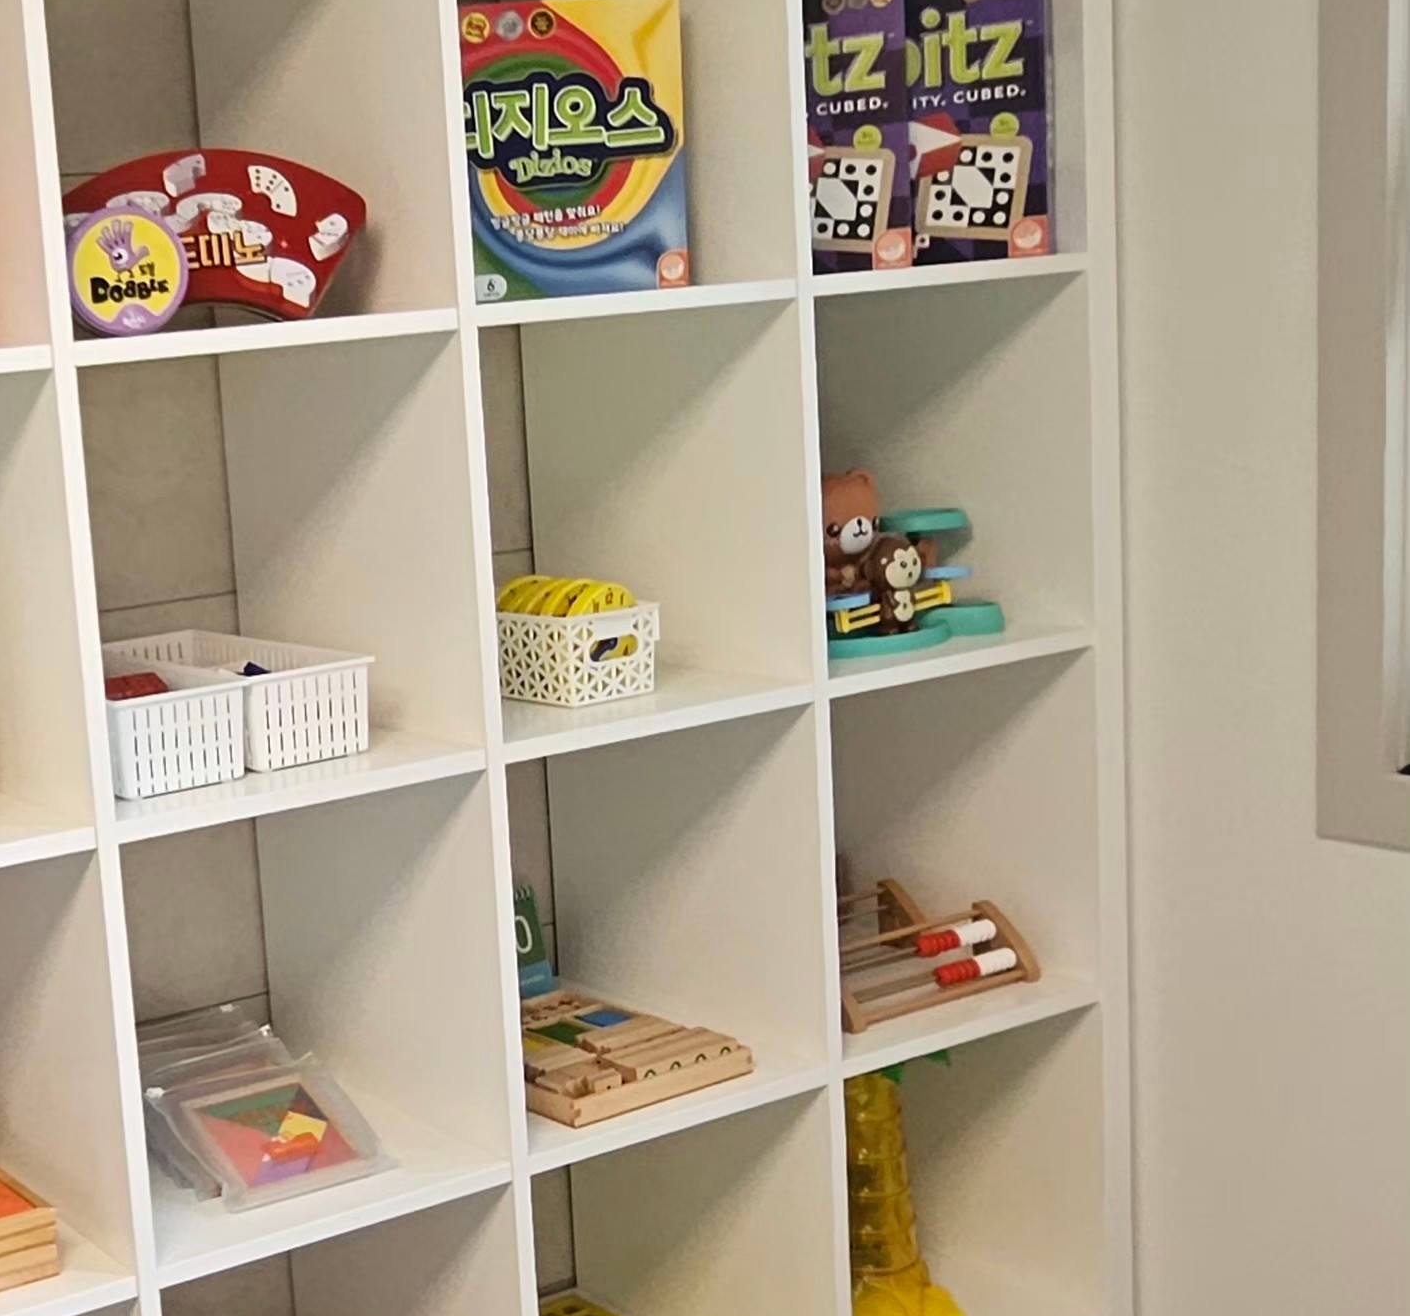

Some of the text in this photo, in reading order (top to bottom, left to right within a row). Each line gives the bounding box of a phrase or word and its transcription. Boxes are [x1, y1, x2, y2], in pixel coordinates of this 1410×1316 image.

[952, 84, 1027, 104] CUBED.
[816, 96, 889, 116] CUBED.
[509, 148, 593, 183] Dizios
